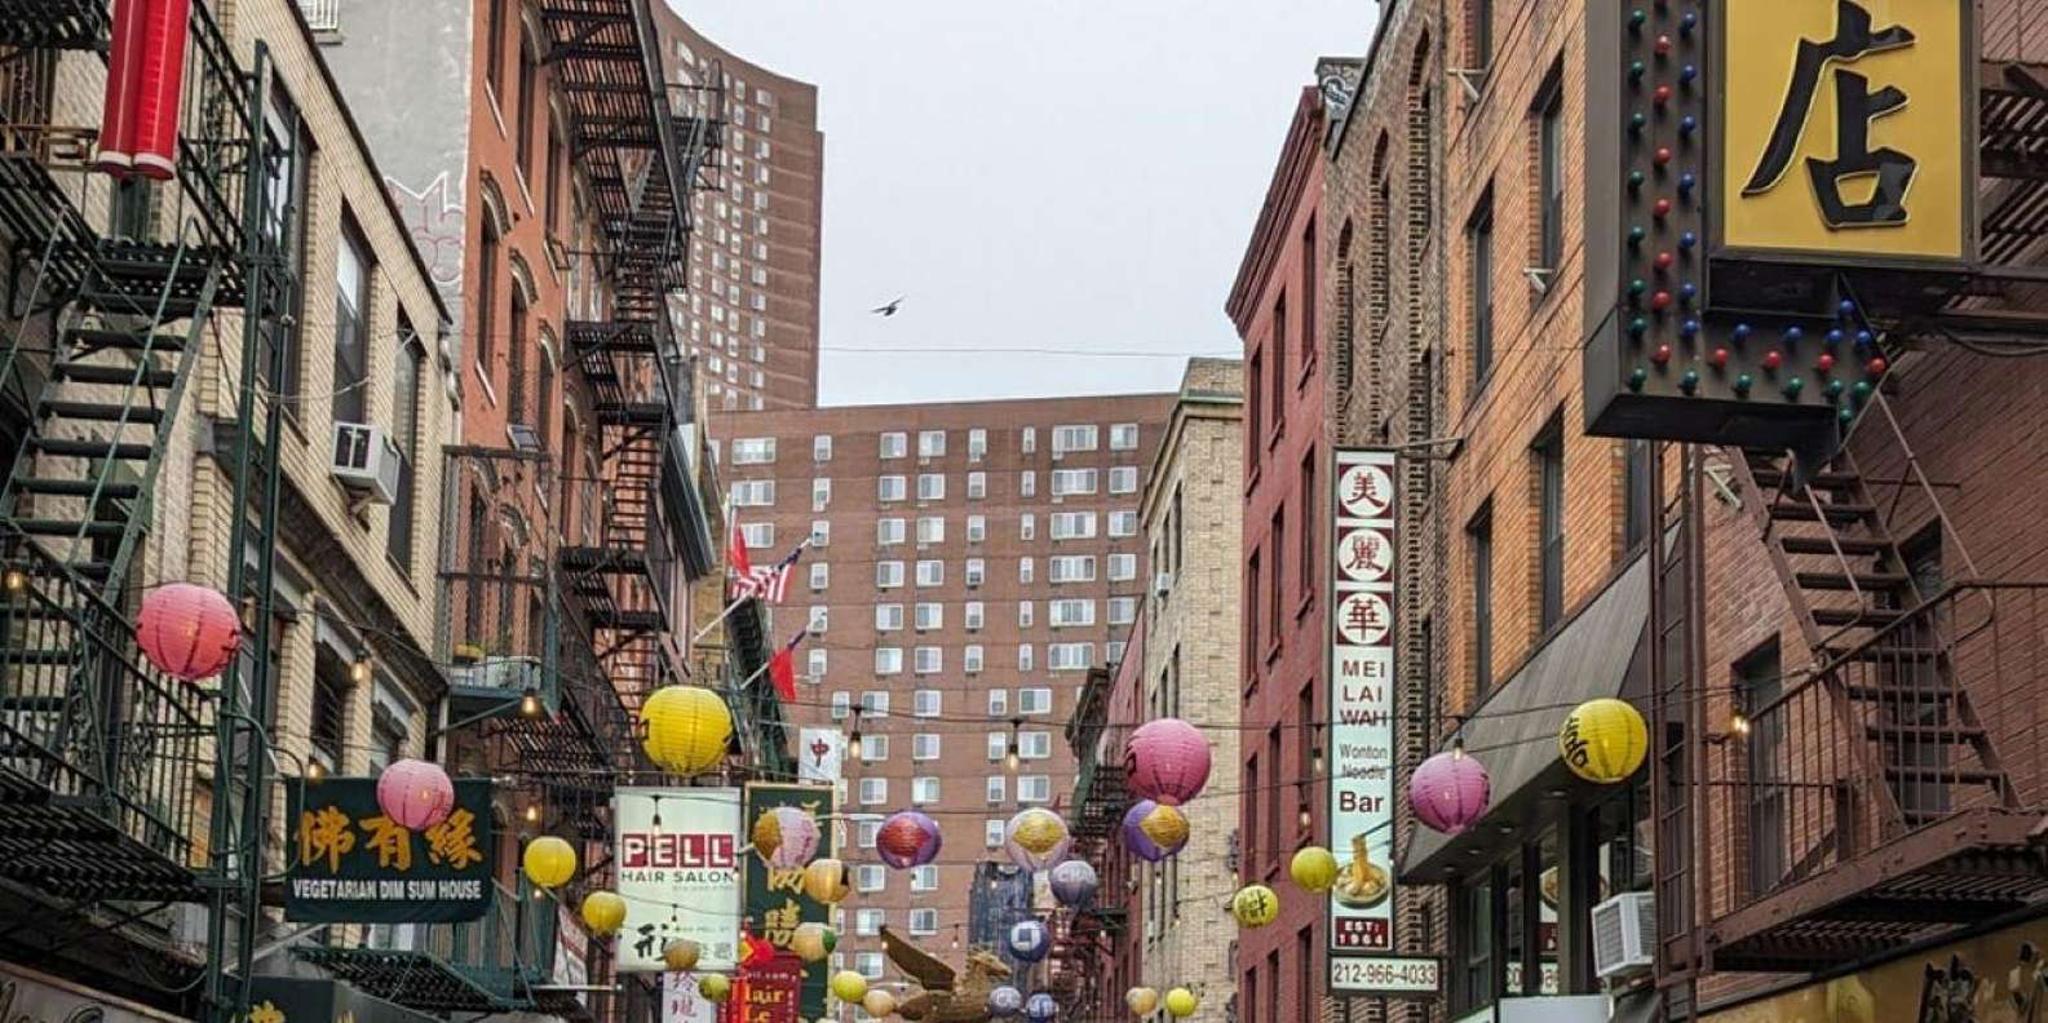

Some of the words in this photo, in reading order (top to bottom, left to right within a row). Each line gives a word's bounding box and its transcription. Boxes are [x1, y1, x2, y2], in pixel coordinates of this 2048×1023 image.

[1741, 0, 1918, 231] 店
[1346, 472, 1387, 642] 美麗華
[1343, 659, 1385, 678] MEI
[1343, 685, 1382, 702] LAI
[1340, 709, 1387, 727] WAH
[1340, 744, 1387, 759] Wonton
[1339, 791, 1385, 813] Bar
[623, 836, 732, 866] PELL
[622, 871, 665, 882] HAIR
[674, 871, 734, 882] SALON
[293, 879, 377, 900] VEGETARIAN
[379, 881, 405, 900] DIM
[407, 881, 436, 900] SUM
[438, 880, 482, 899] HOUSE
[1334, 963, 1436, 985] 212-966-4033
